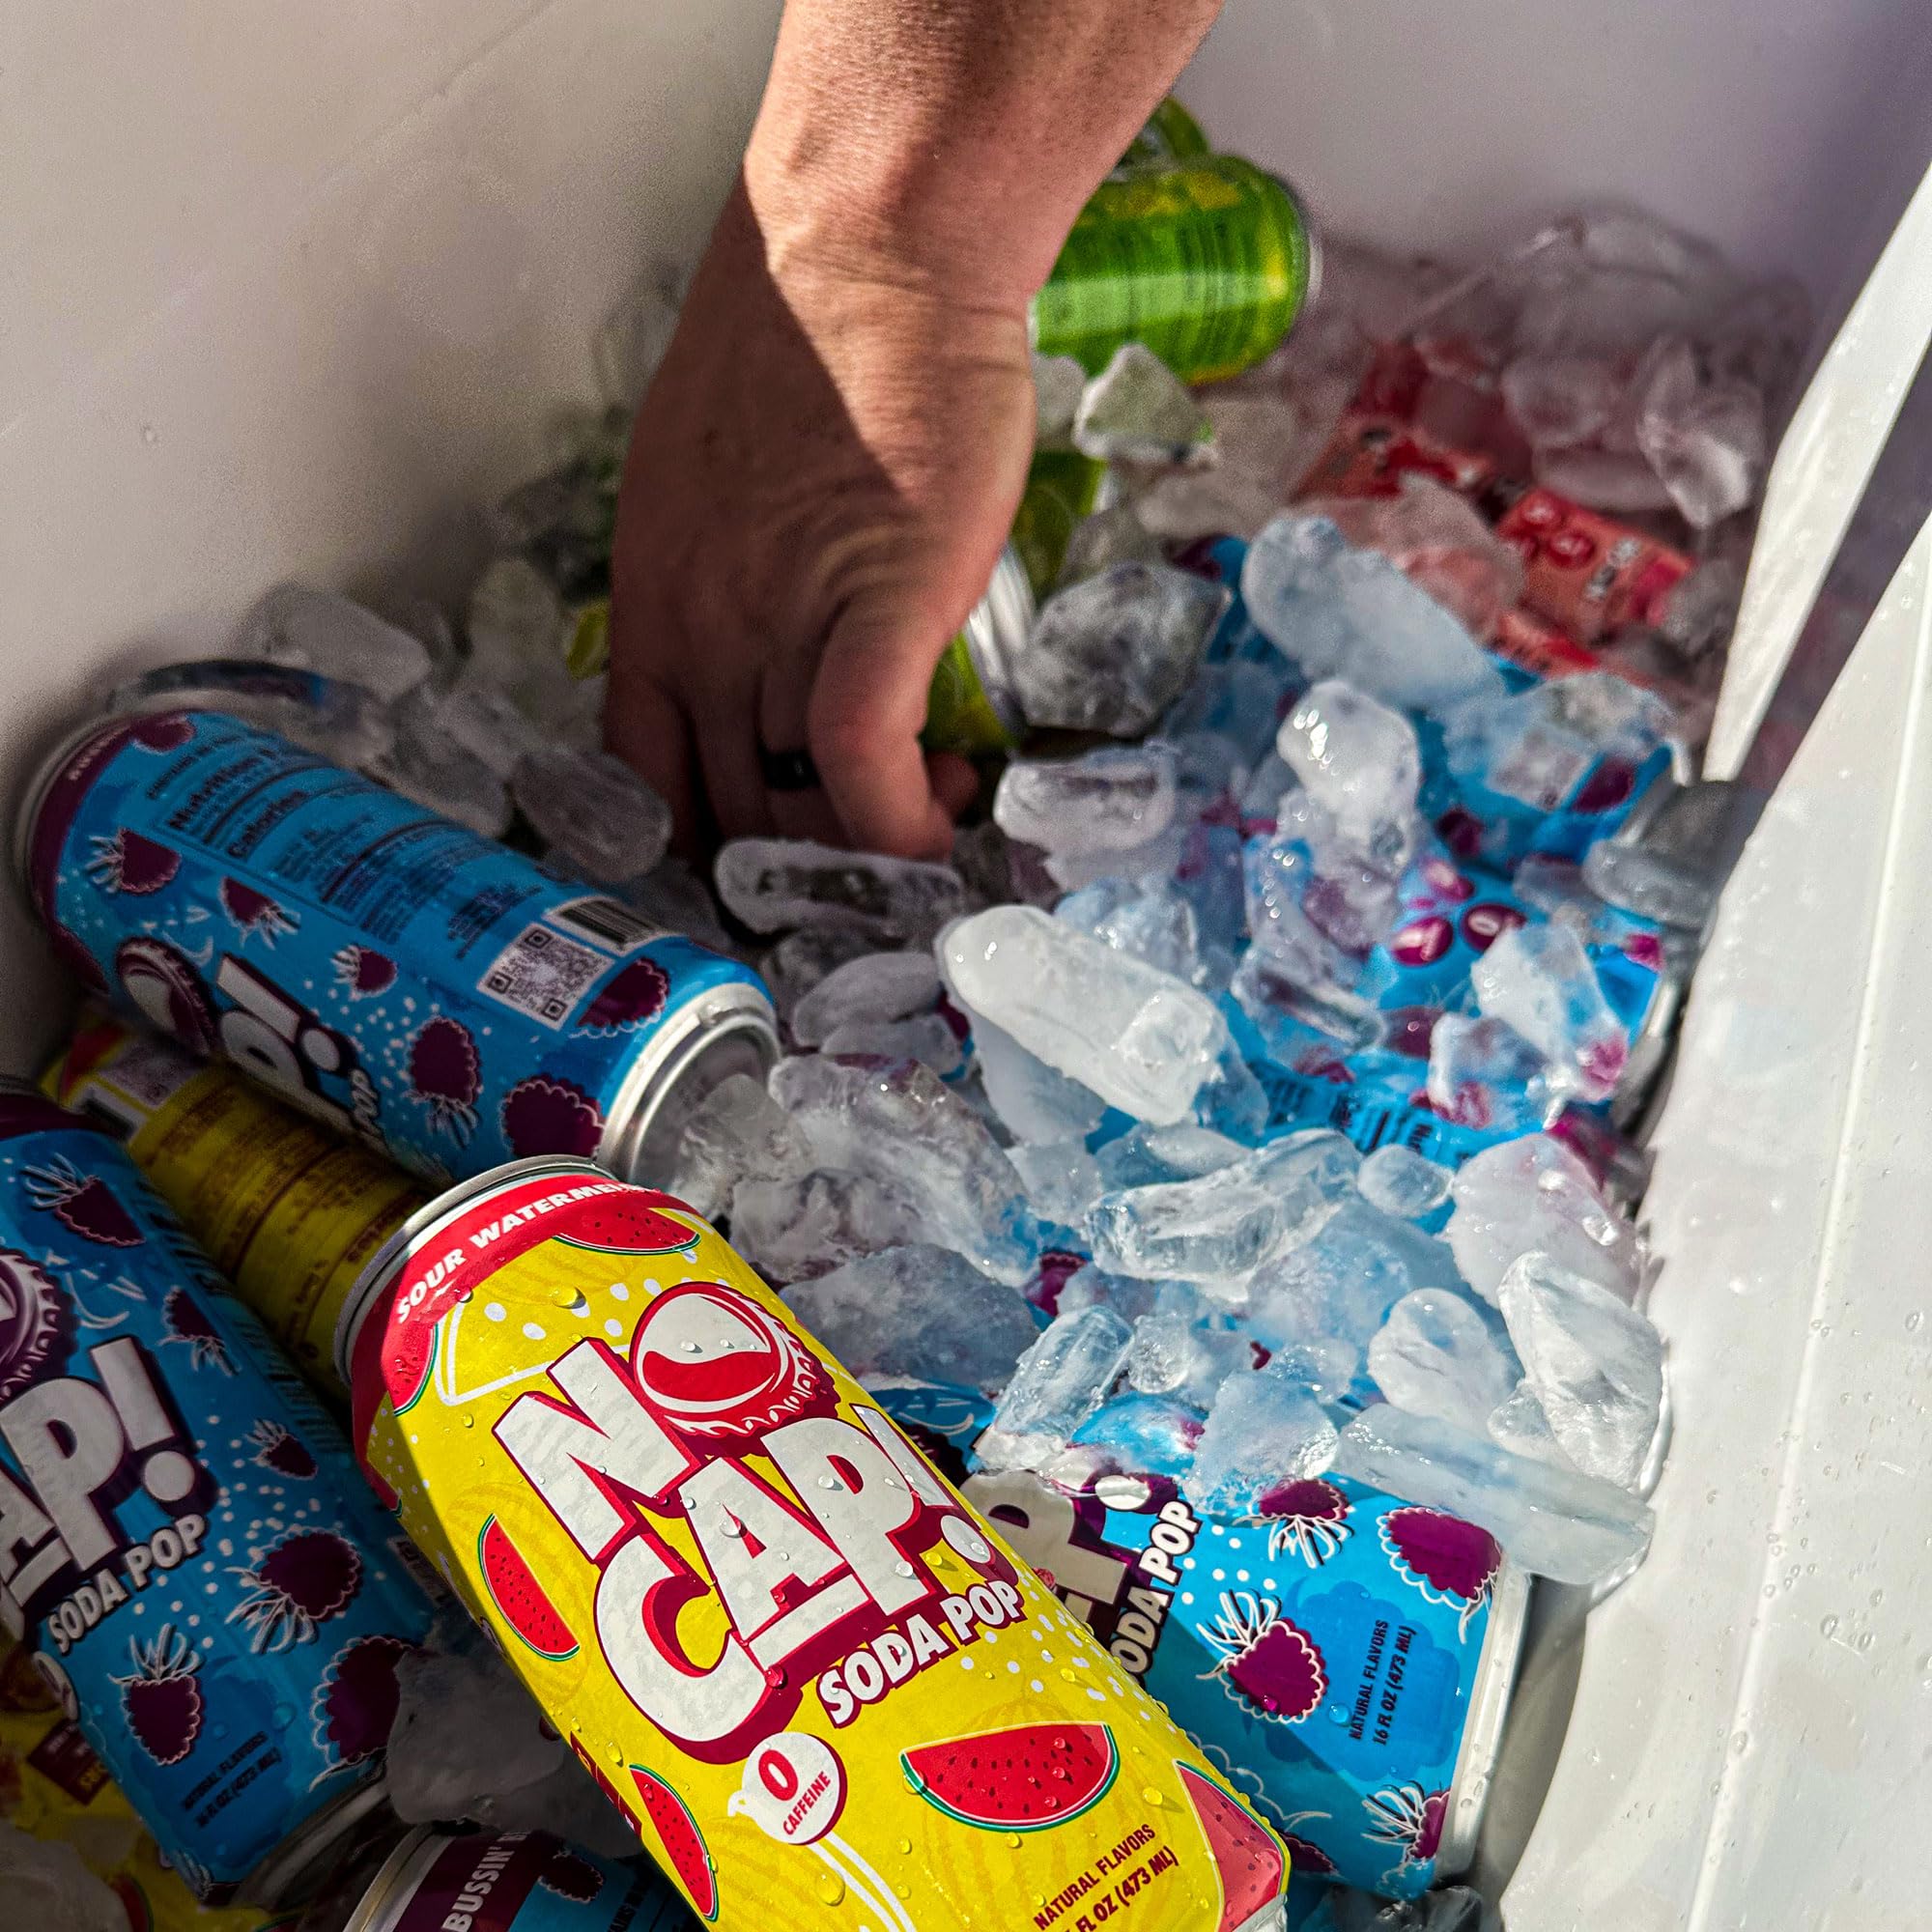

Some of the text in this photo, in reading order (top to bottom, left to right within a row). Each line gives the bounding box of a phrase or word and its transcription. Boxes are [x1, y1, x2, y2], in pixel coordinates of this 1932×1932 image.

[397, 1182, 660, 1324] SOUR WATERMEL
[493, 1282, 835, 1560] NO
[48, 1513, 206, 1655] SODA POP
[593, 1404, 995, 1748] CAP!
[1110, 1499, 1203, 1674] ODA POP
[818, 1579, 1022, 1725] SODA POP
[1349, 1619, 1389, 1740] NATURAL FLAVORS
[1373, 1625, 1417, 1746] 16 FL OZ (473 ML)
[757, 1749, 799, 1802] 0
[783, 1771, 832, 1835] CAFFEINE
[441, 1846, 515, 1932] BUSSIN'
[1034, 1824, 1156, 1930] NATURAL FLAVORS
[1093, 1893, 1119, 1922] OZ
[1114, 1866, 1151, 1908] (473
[1148, 1845, 1179, 1876] ML)
